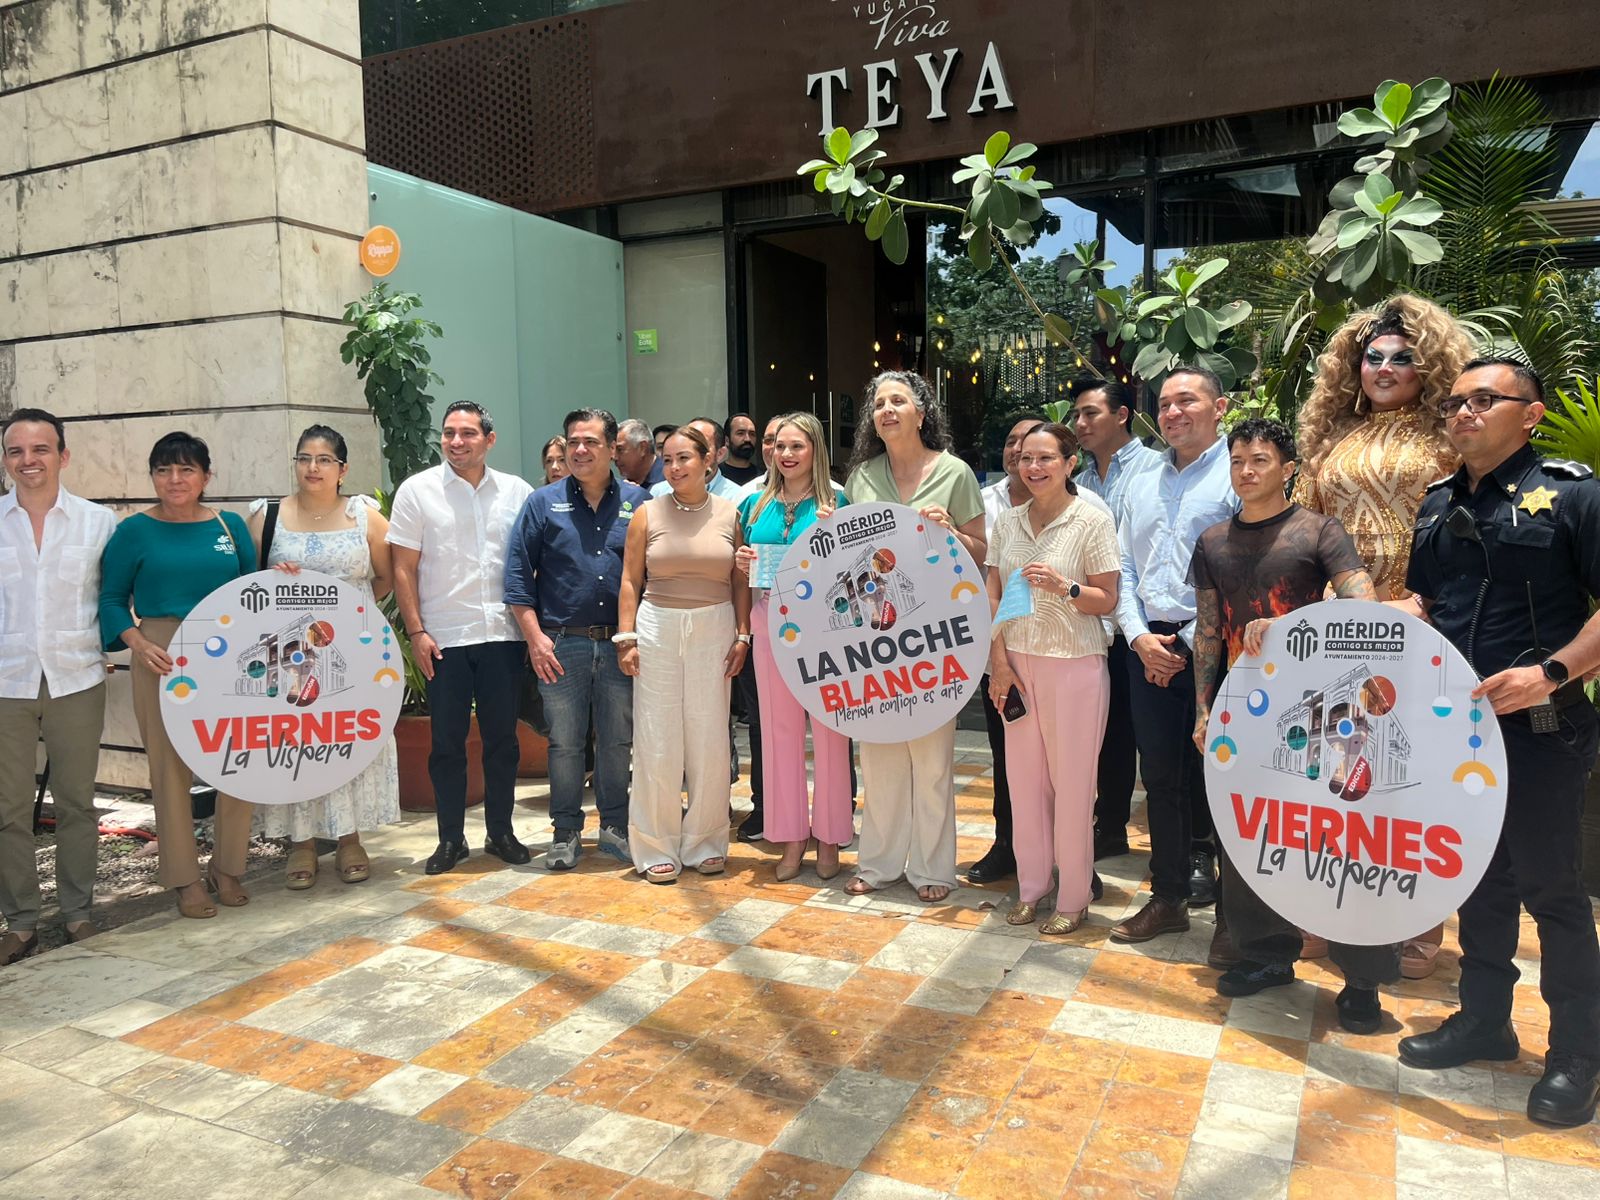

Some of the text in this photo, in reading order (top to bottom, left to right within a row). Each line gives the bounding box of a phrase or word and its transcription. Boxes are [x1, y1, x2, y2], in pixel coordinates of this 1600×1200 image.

[869, 5, 951, 50] Viva
[806, 41, 1014, 137] TEYA
[837, 509, 895, 536] MÉRIDA
[275, 582, 338, 597] MÉRIDA
[797, 615, 974, 685] LA NOCHE
[1325, 618, 1405, 639] MÉRIDA
[1326, 642, 1402, 651] CONTIGO ES MEJOR
[819, 654, 969, 713] BLANCA
[835, 678, 963, 727] Mérida contigo es arte
[192, 709, 381, 754] VIERNES
[221, 735, 251, 776] La
[1347, 761, 1366, 792] EDICIÓN
[1230, 792, 1463, 879] VIERNES
[1256, 823, 1287, 875] La
